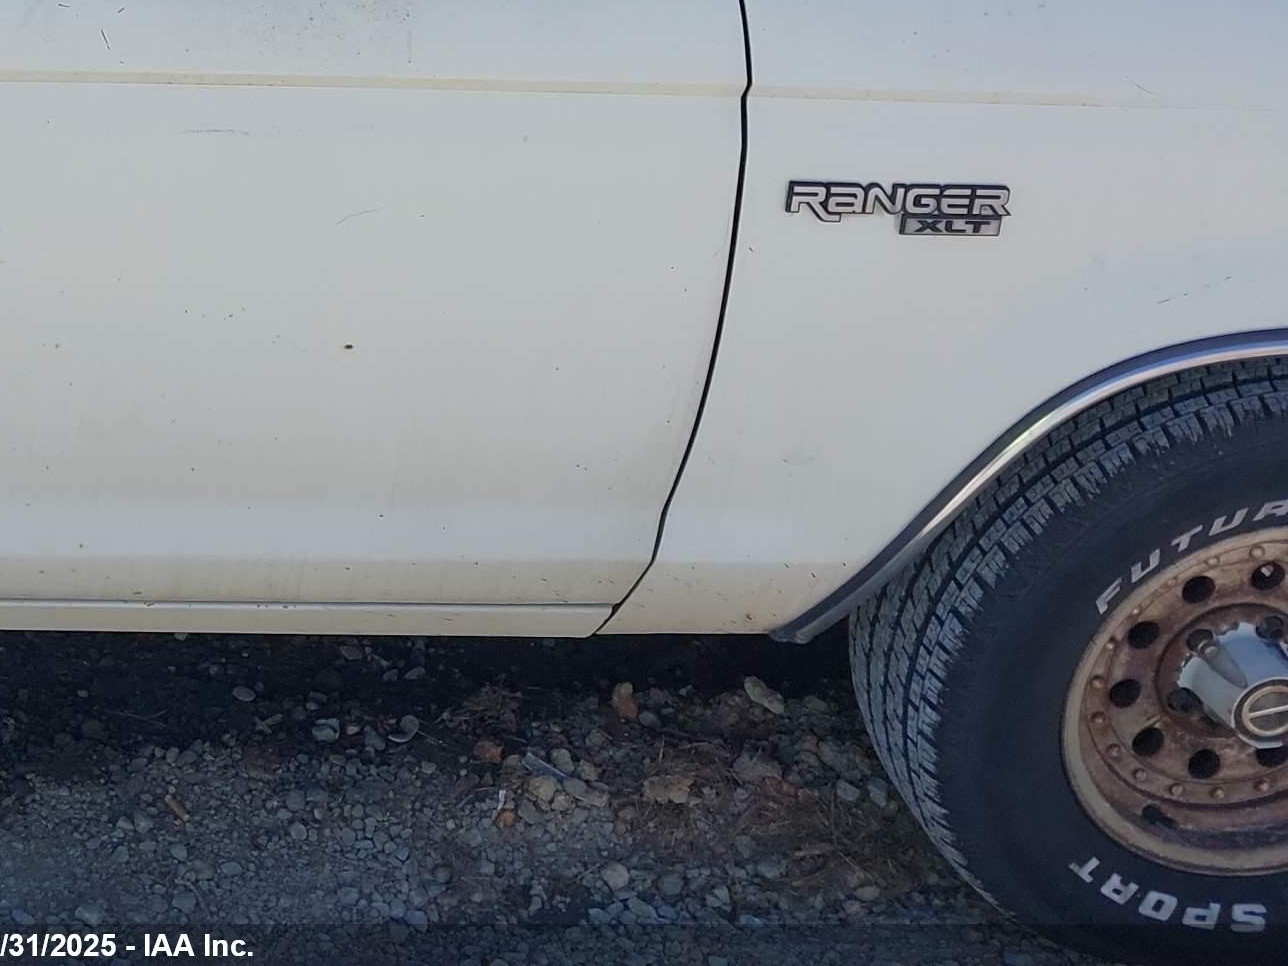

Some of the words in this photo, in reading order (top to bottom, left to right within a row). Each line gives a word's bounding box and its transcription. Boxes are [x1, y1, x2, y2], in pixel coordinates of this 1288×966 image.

[785, 180, 1012, 222] RANGER
[914, 220, 990, 234] XLT
[1067, 857, 1267, 933] SPORT
